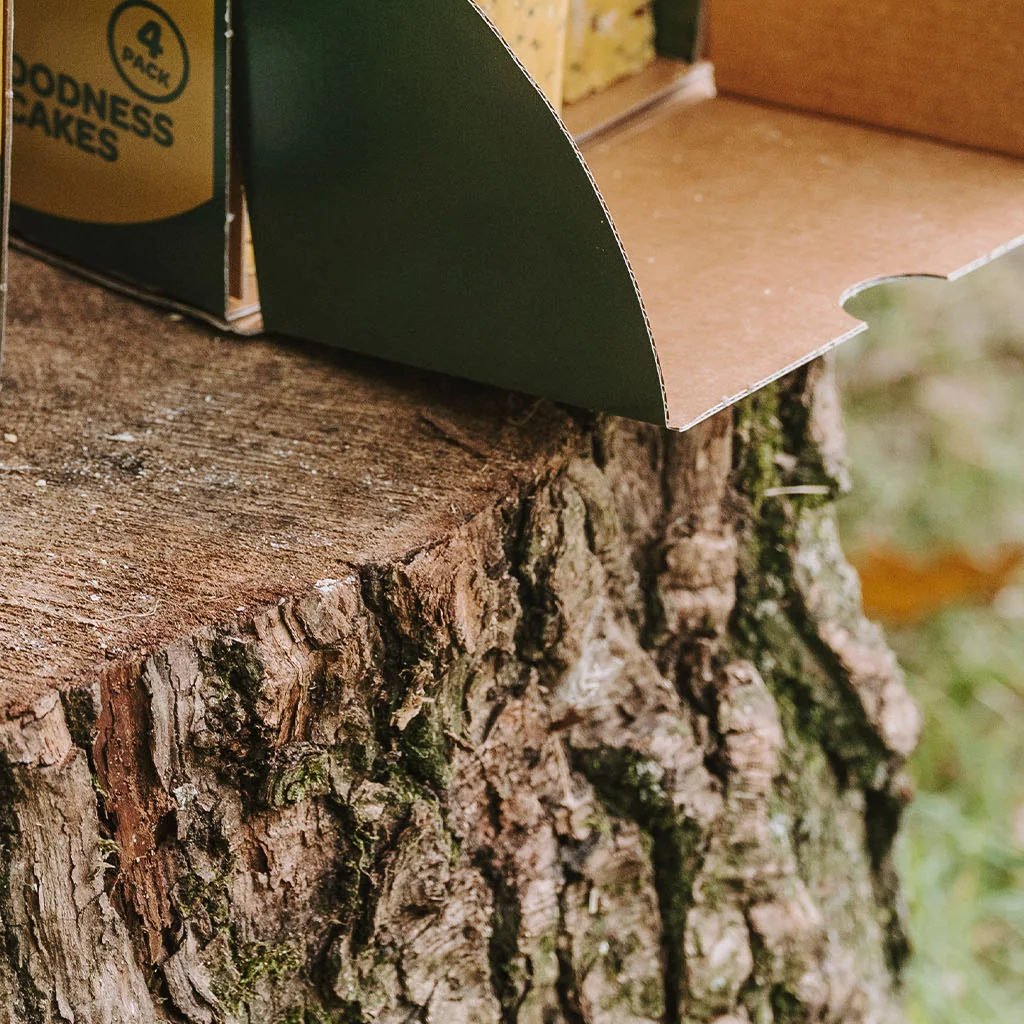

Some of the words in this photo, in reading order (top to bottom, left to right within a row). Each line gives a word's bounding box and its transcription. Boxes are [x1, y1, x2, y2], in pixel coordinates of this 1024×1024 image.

[137, 20, 163, 59] 4
[122, 45, 169, 89] PACK
[13, 52, 174, 147] OODNESS
